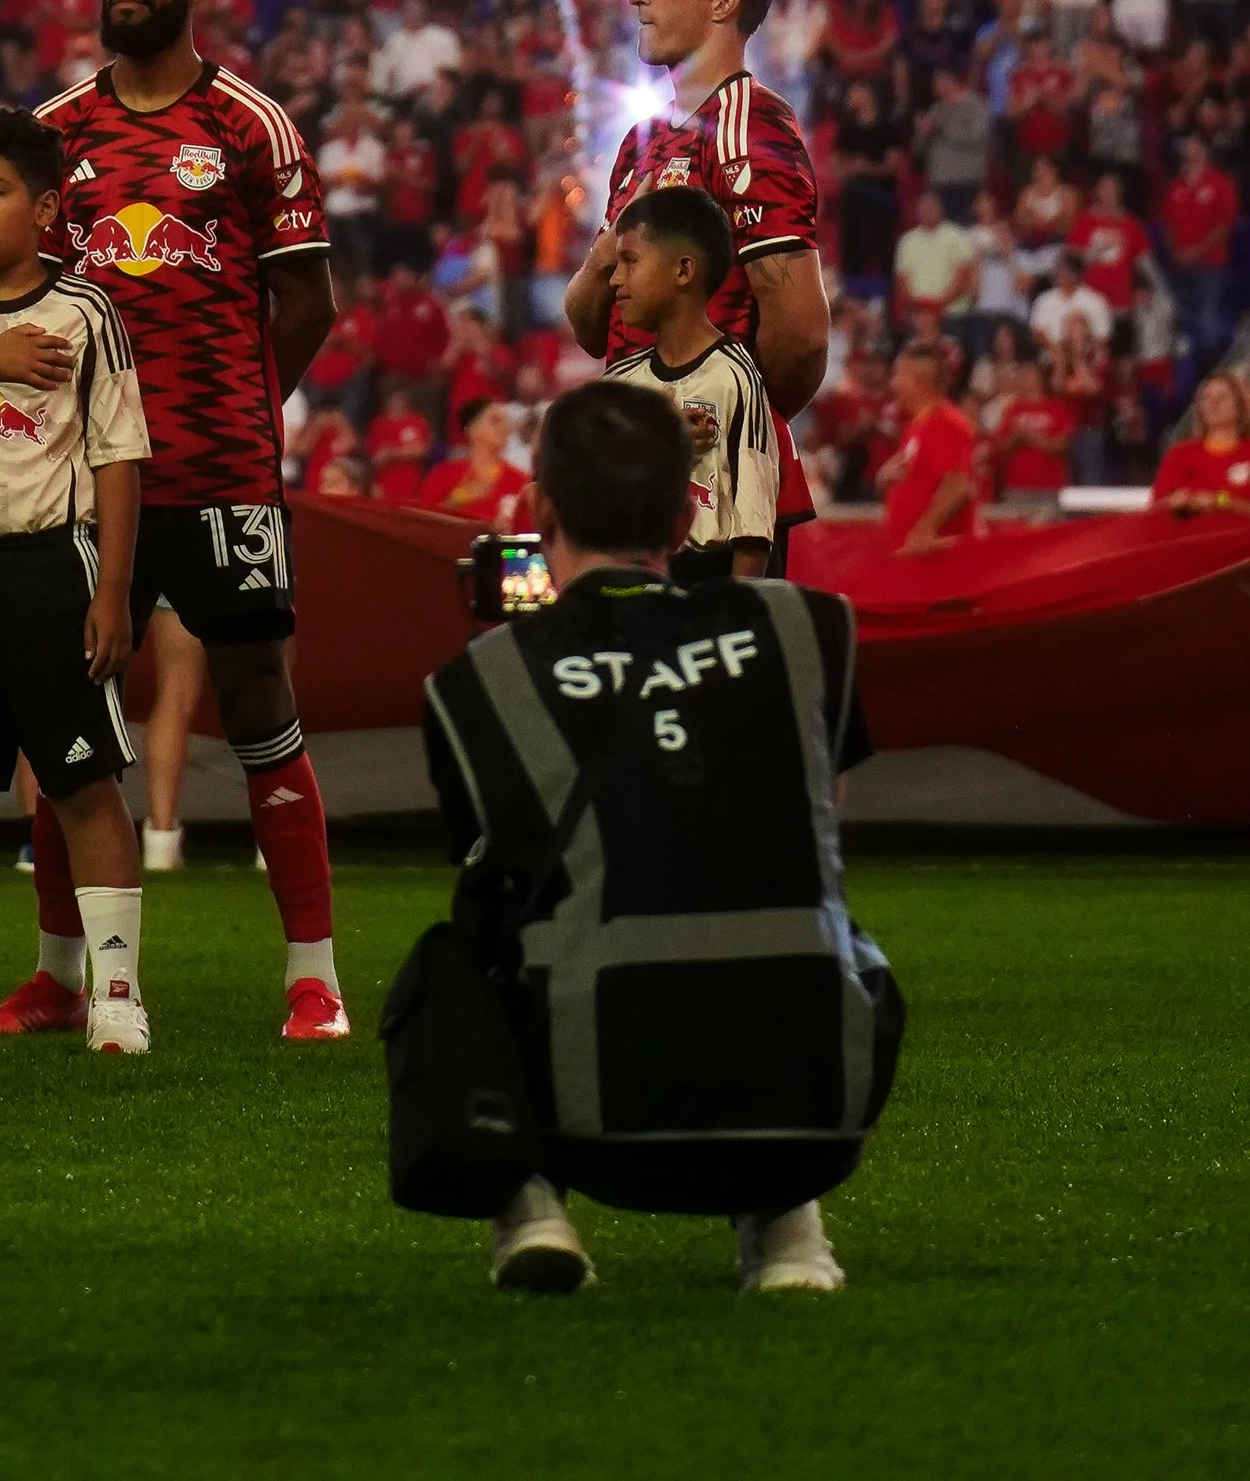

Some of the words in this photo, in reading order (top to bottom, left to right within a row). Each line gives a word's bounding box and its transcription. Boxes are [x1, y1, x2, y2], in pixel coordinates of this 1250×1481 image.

[277, 170, 292, 180] MLS
[725, 165, 740, 175] MLS
[291, 209, 312, 228] tv
[744, 206, 763, 225] tv
[199, 504, 274, 567] 13
[553, 629, 758, 700] STAFF
[654, 709, 688, 751] 5
[65, 748, 94, 763] adidas
